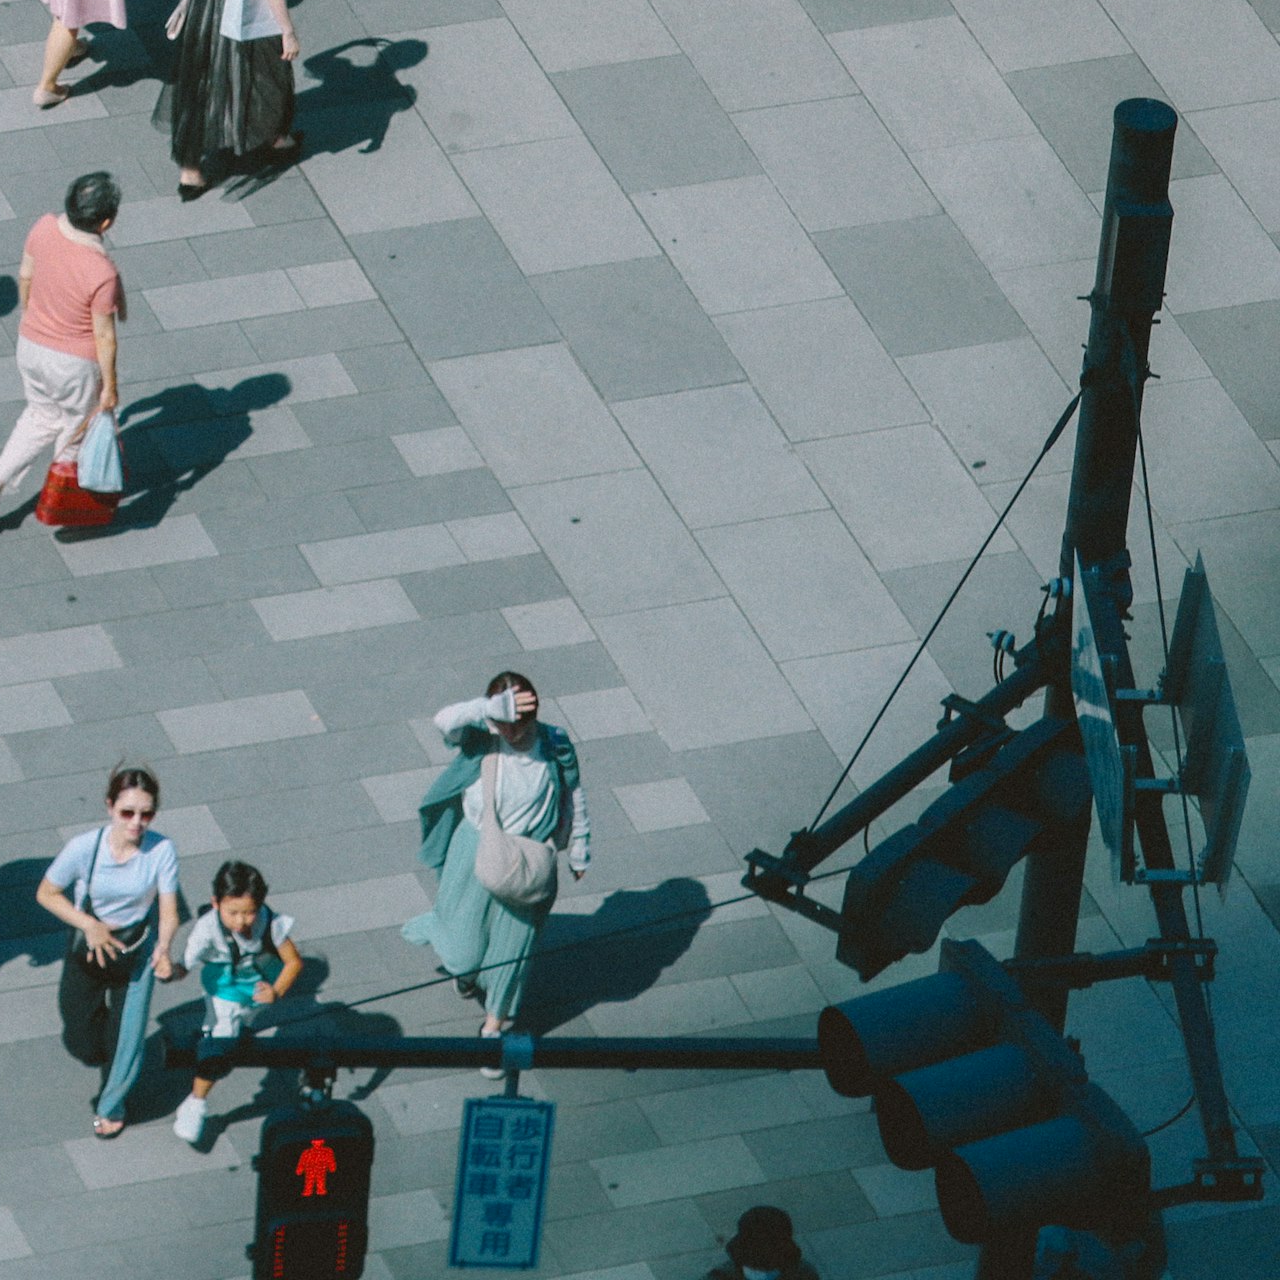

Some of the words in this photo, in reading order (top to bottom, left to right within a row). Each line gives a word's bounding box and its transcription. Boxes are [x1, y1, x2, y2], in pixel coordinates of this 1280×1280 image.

[468, 1115, 503, 1197] 自転車
[506, 1116, 543, 1200] 歩行者
